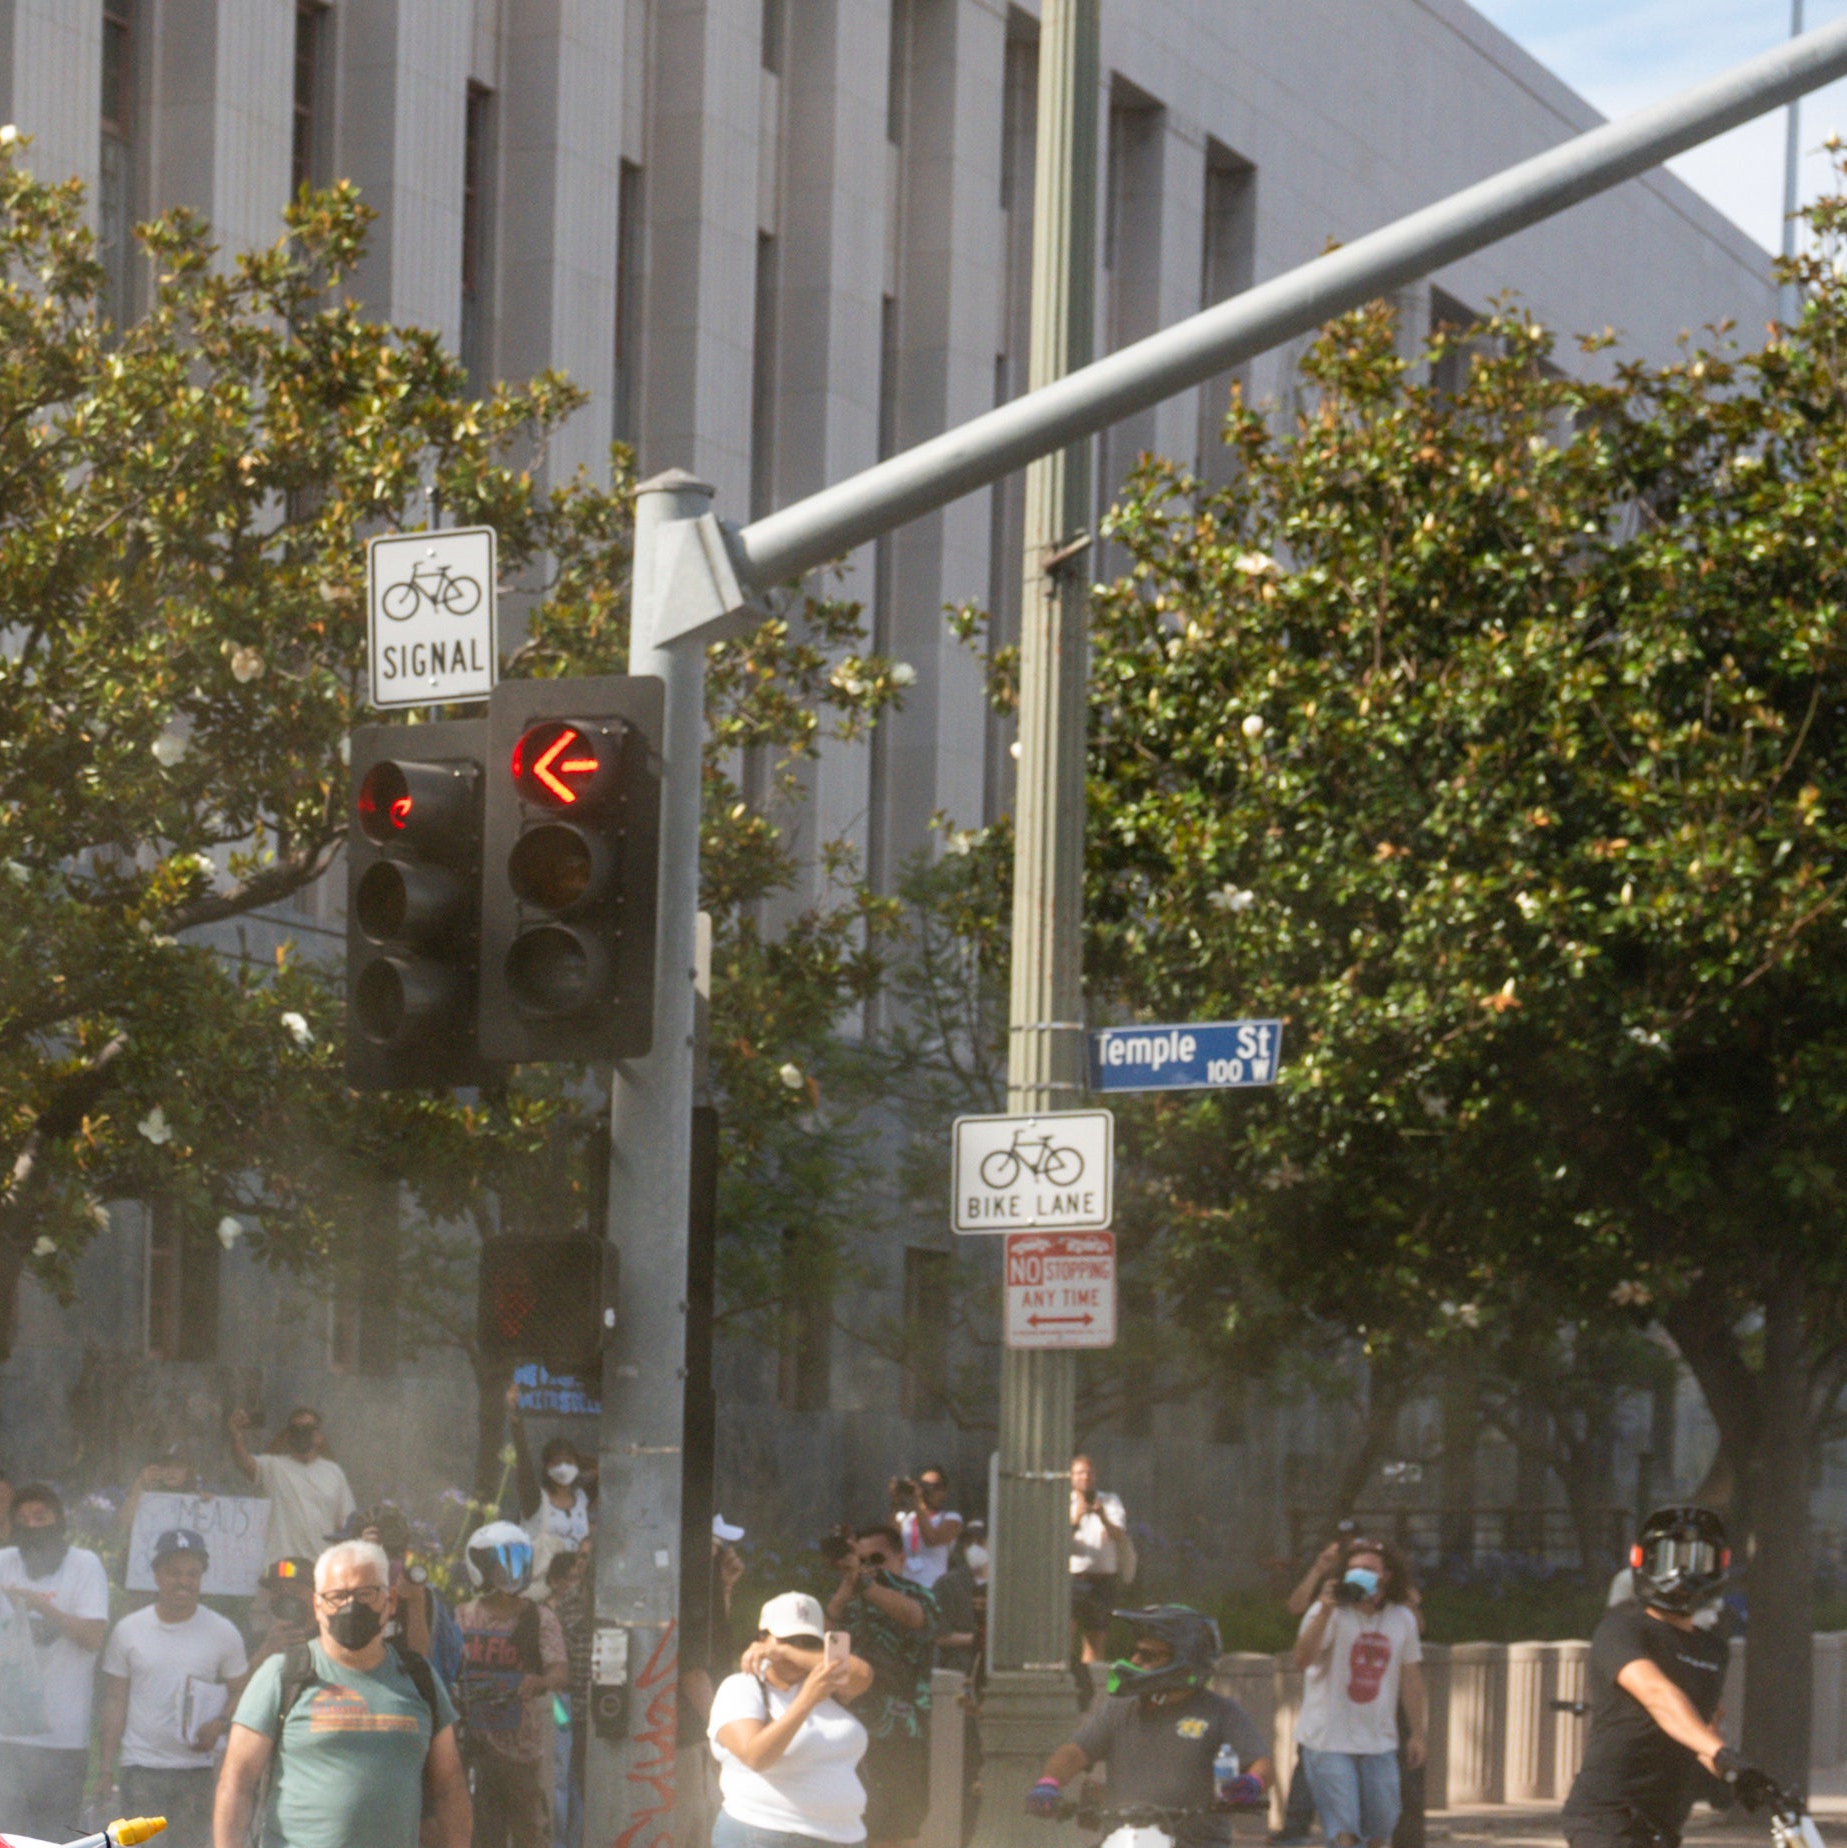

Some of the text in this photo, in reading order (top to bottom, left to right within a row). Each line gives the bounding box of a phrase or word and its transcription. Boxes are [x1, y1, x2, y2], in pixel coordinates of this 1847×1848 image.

[383, 638, 484, 680] SIGNAL
[1098, 1025, 1270, 1071] Temple St
[1207, 1059, 1270, 1083] 100 W
[967, 1192, 1096, 1219] BIKE LANE
[1009, 1257, 1111, 1283] NO STOPPING
[1022, 1288, 1100, 1307] ANY TIME
